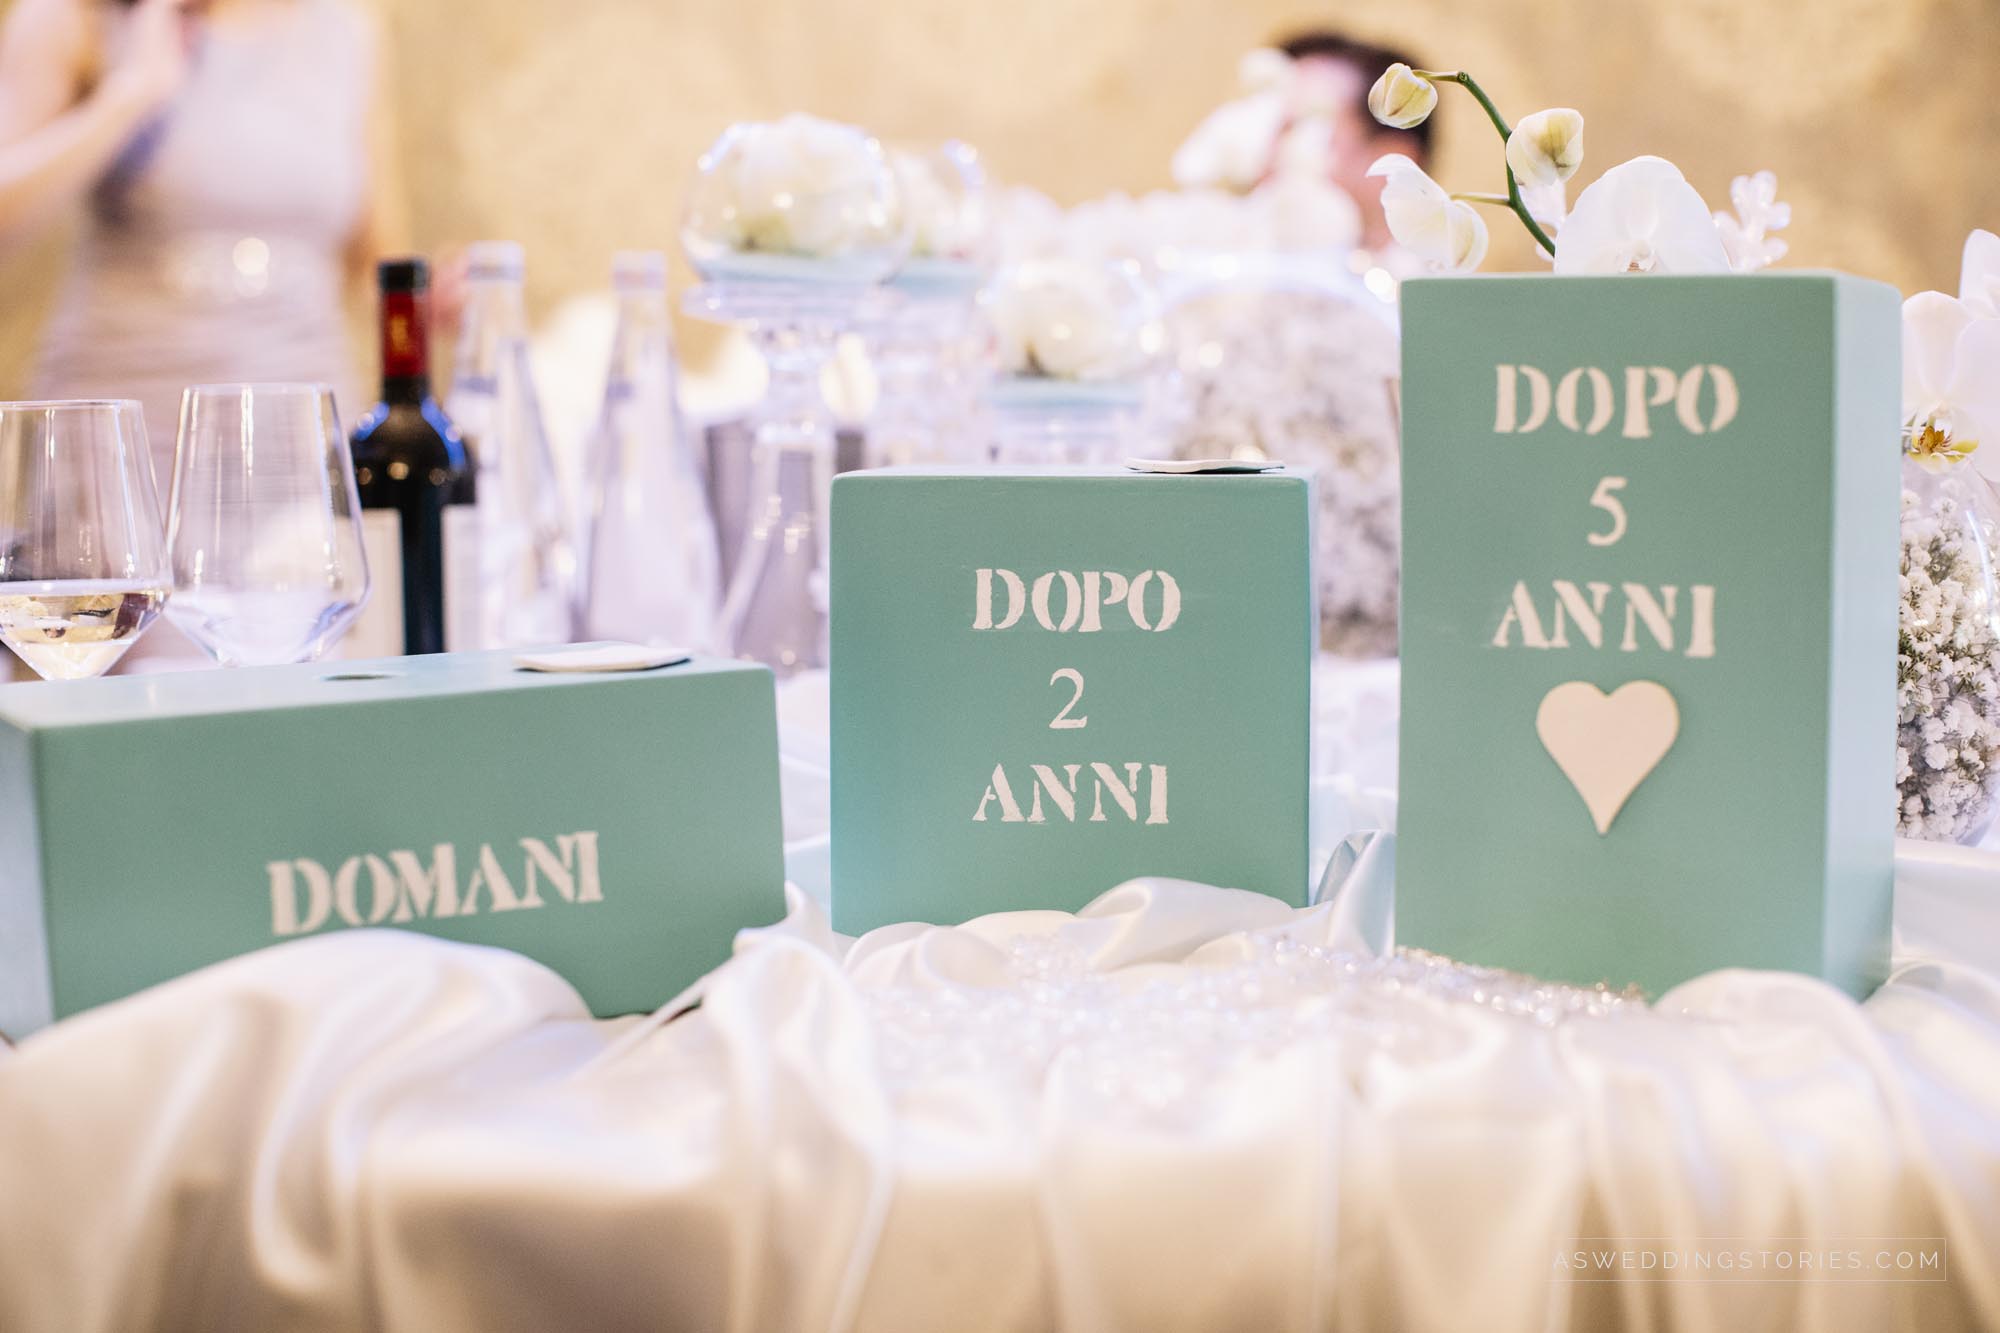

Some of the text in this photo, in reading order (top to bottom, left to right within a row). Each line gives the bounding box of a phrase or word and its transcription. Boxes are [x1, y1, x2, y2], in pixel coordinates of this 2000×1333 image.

[1493, 364, 1739, 438] DOPO
[1587, 476, 1628, 546] 5
[972, 568, 1181, 632] DOPO
[1491, 579, 1715, 658] ANNI
[1049, 668, 1088, 729] 2
[972, 762, 1169, 824] ANNI
[266, 830, 603, 936] DOMANI
